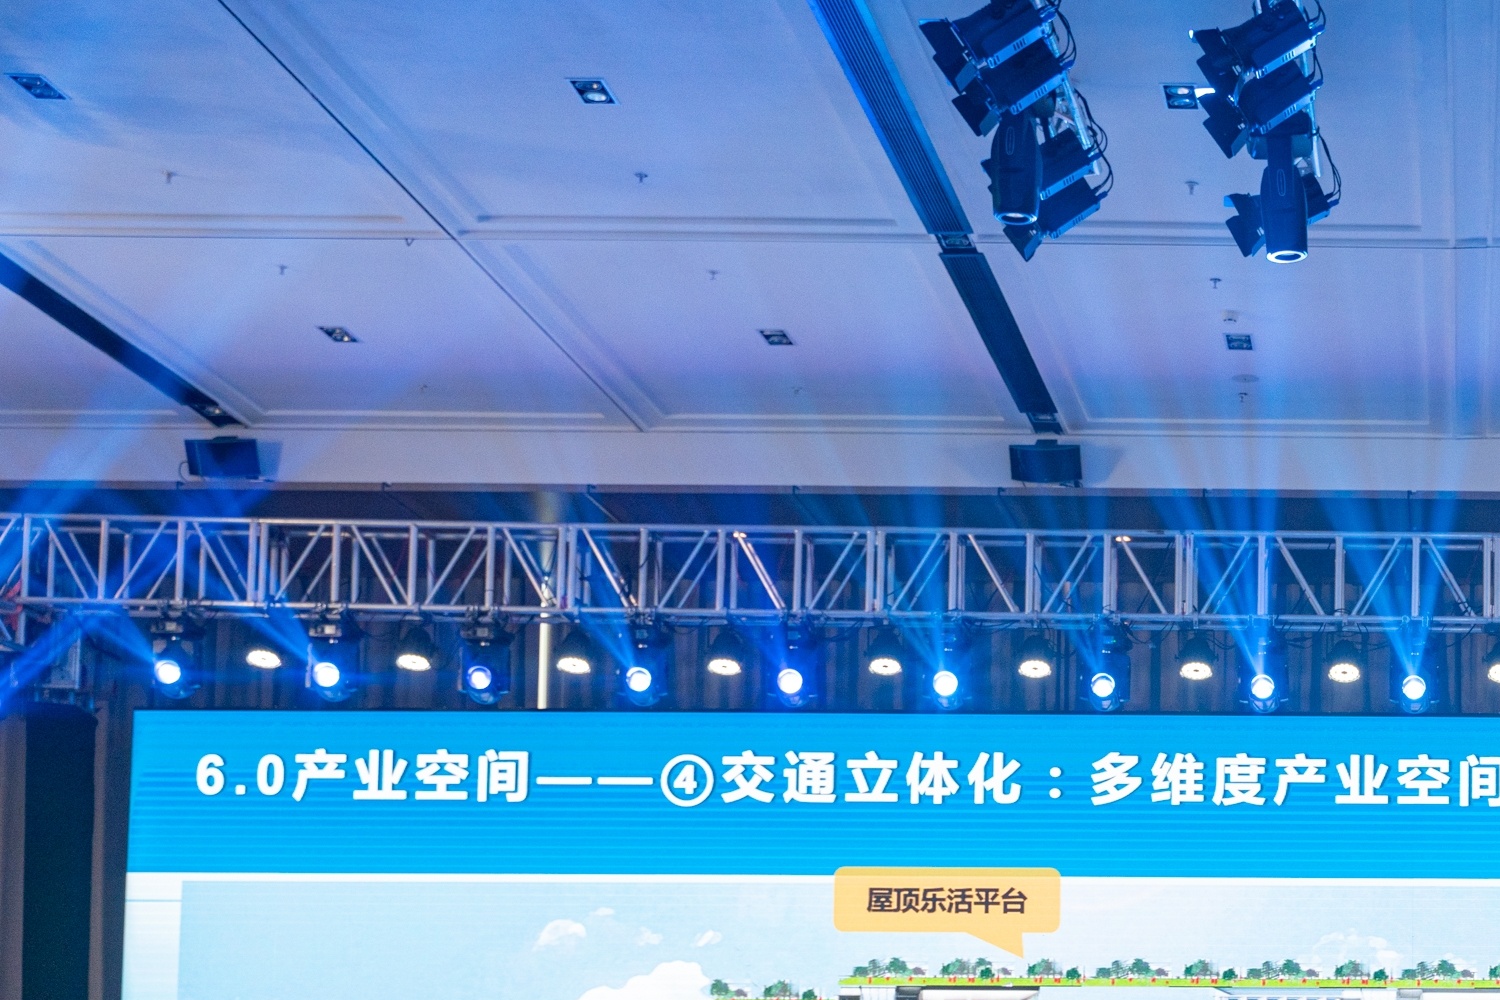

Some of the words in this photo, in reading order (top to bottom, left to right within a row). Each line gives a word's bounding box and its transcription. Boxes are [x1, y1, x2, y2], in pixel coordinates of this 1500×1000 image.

[866, 886, 1028, 916] 屋顶乐活平台
